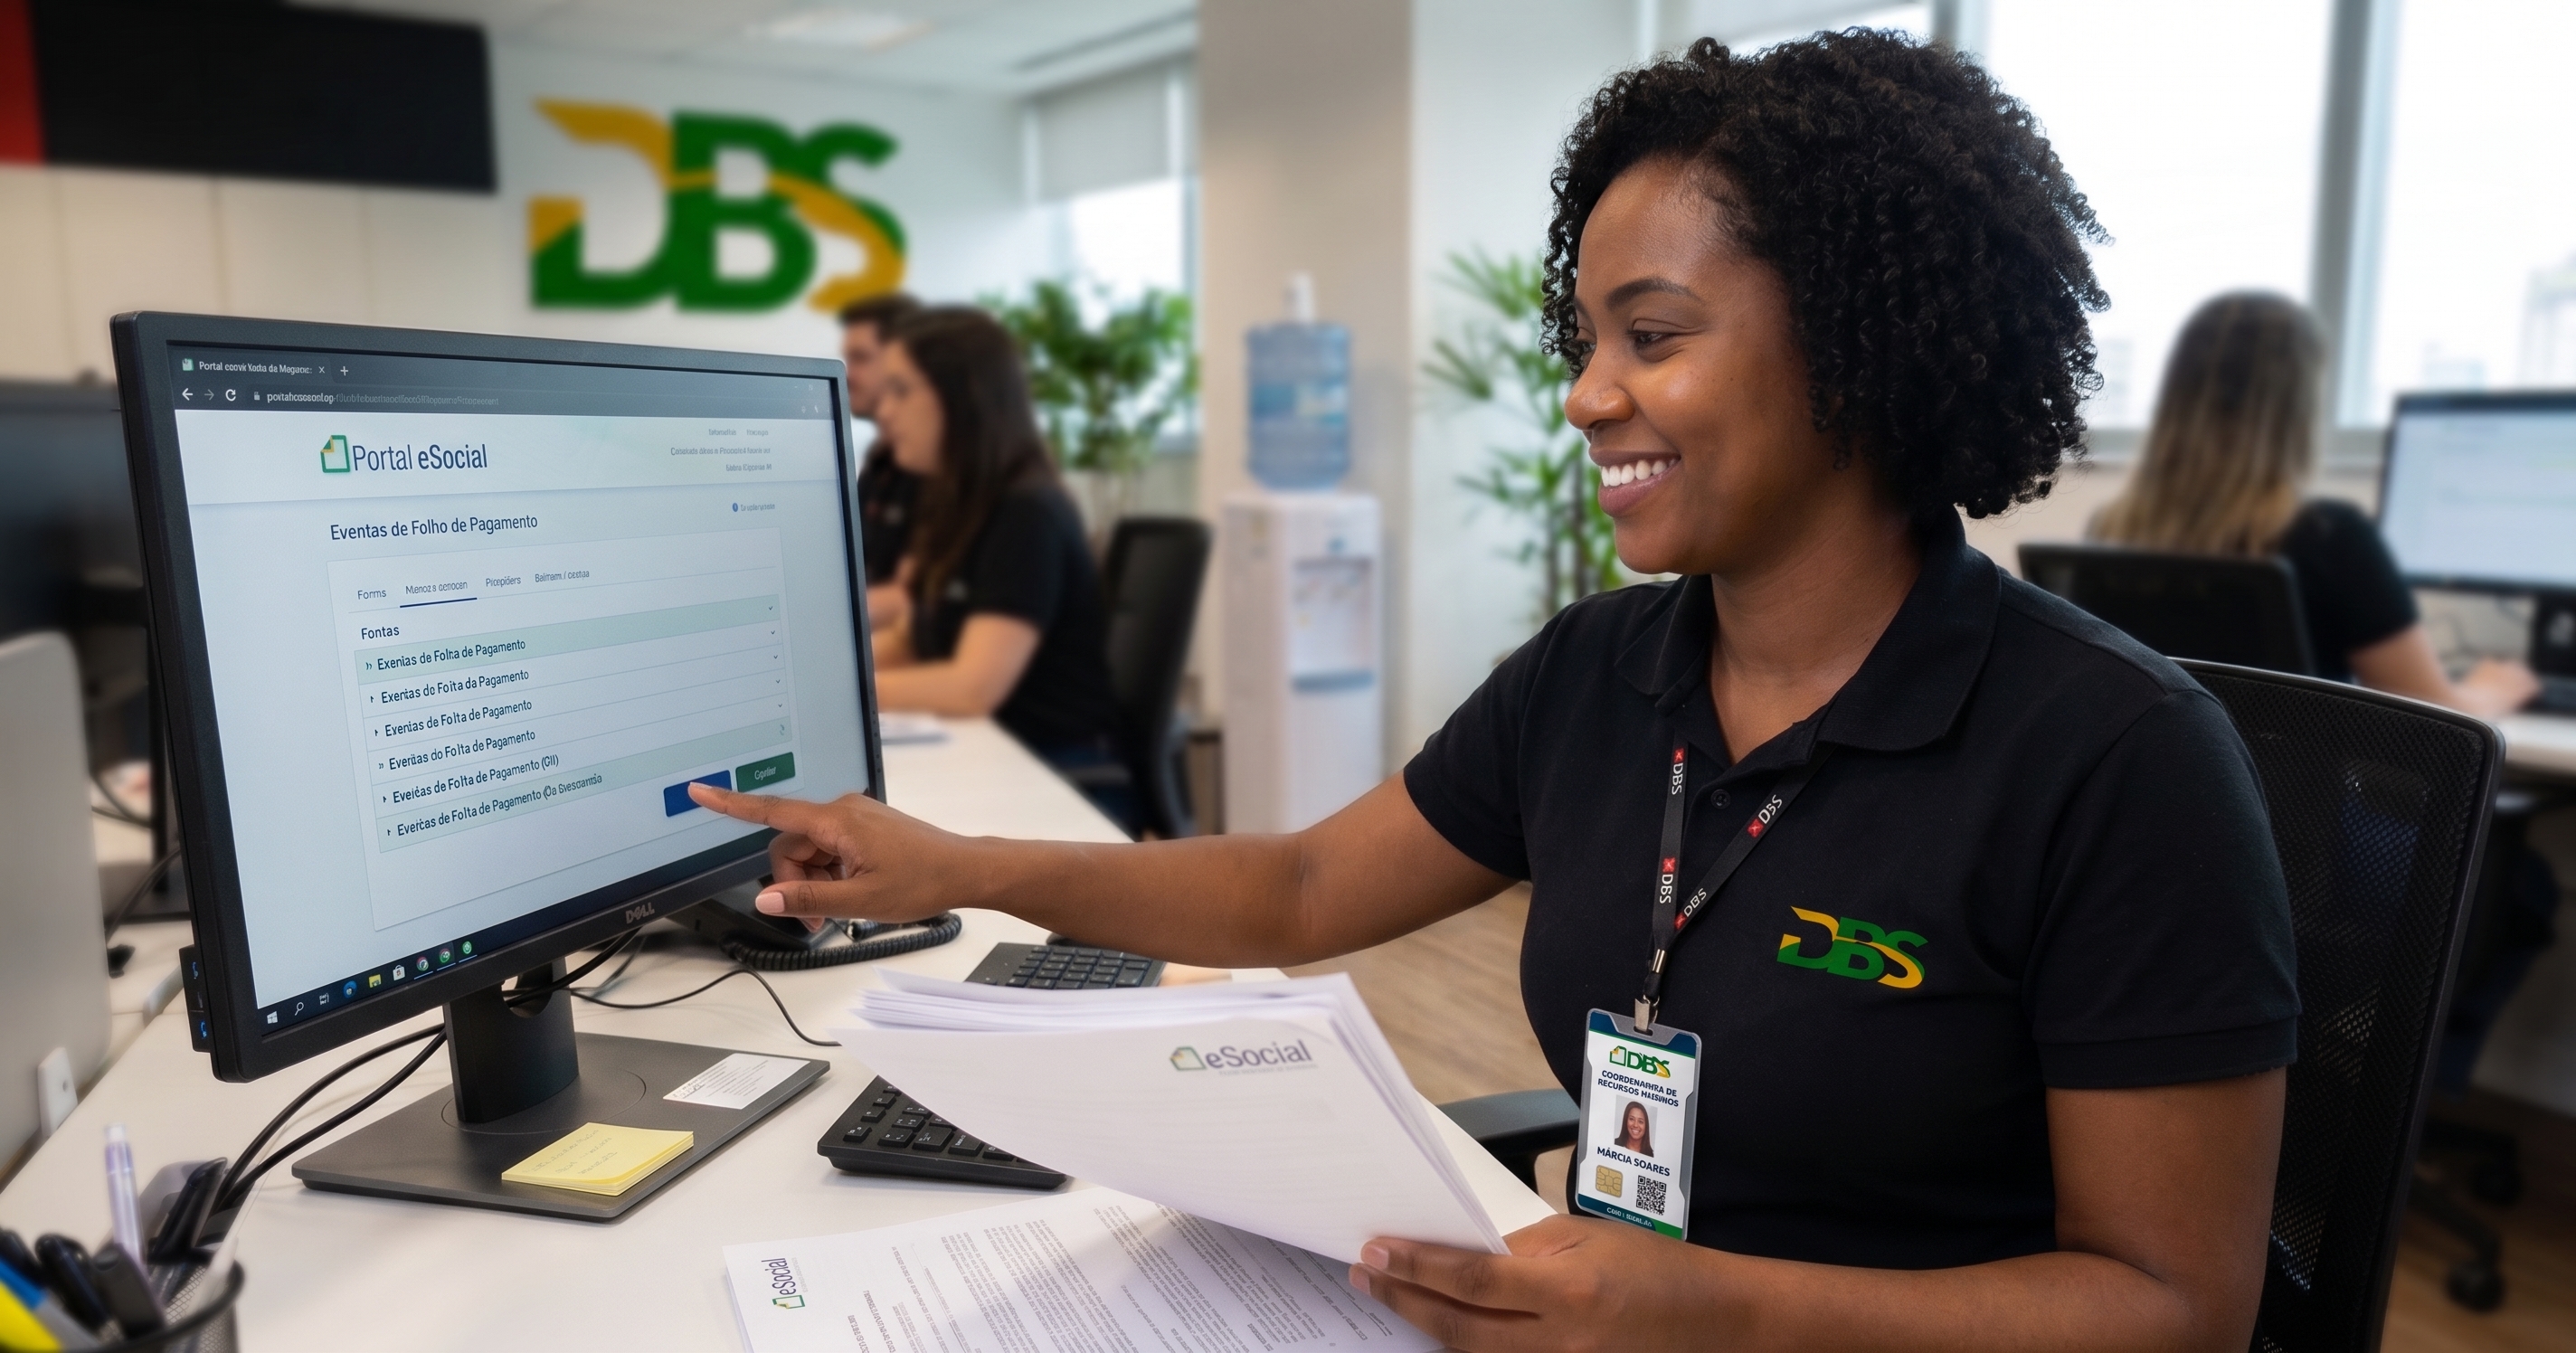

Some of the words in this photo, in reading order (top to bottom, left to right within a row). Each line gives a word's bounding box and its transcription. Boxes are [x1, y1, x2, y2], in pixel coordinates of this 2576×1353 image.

[528, 97, 907, 314] DBS
[199, 361, 223, 372] Portal
[352, 444, 412, 471] Portal
[418, 443, 488, 469] eSocial
[330, 524, 388, 540] Eventas
[391, 521, 408, 537] de
[412, 519, 448, 535] Folho
[451, 517, 467, 533] de
[469, 515, 538, 535] Pagamento
[357, 590, 387, 600] Forms
[361, 626, 400, 639] Fontas
[420, 652, 431, 665] de
[461, 646, 473, 658] de
[475, 639, 526, 658] Pagamento
[478, 669, 529, 688] Pagamento
[427, 716, 439, 729] de
[469, 708, 481, 721] de
[482, 700, 532, 719] Pagamento
[472, 740, 484, 752] de
[486, 730, 535, 751] Pagamento
[433, 780, 446, 794] de
[476, 771, 488, 784] de
[489, 760, 540, 781] Pagamento
[1672, 762, 1684, 795] DBS
[438, 812, 450, 826] de
[478, 801, 490, 815] de
[492, 790, 542, 811] Pagamento
[1776, 905, 1928, 989] DBS
[1205, 1039, 1313, 1069] eSocial
[1597, 1078, 1639, 1095] RECURSOS
[1666, 1087, 1677, 1097] DE
[1596, 1146, 1633, 1165] MÁRCIA
[1634, 1158, 1671, 1177] SOARES
[761, 1258, 797, 1295] eSocial
